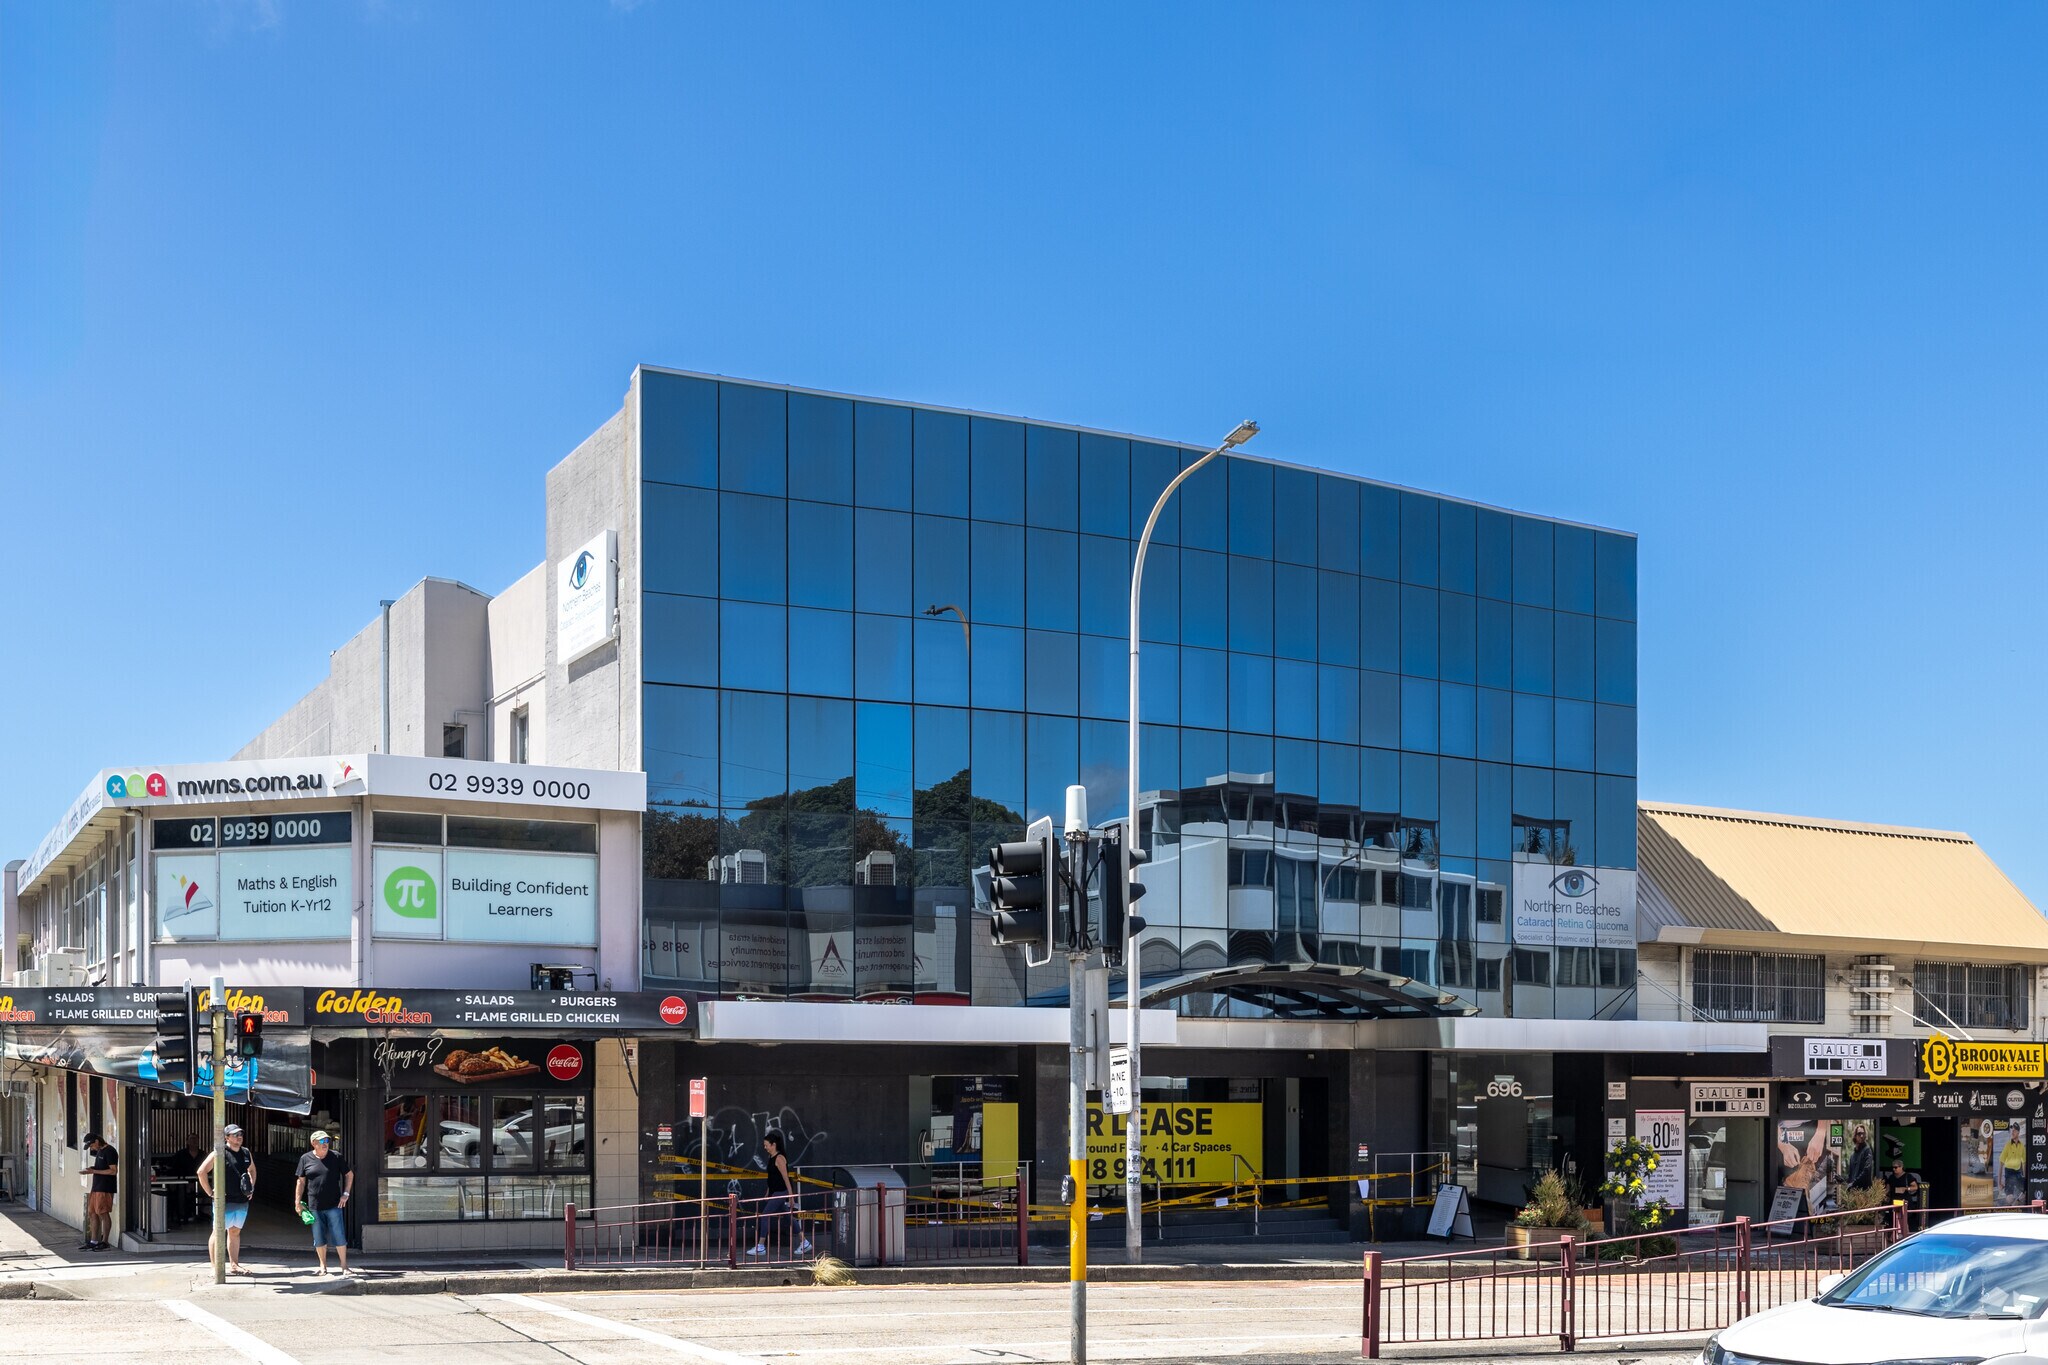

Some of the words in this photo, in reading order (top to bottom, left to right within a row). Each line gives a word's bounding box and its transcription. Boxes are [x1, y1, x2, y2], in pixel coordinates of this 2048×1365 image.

[178, 773, 322, 797] mwns.com.au
[429, 772, 457, 791] 02
[466, 775, 523, 796] 9939
[533, 780, 591, 800] 0000
[190, 824, 213, 842] 02
[223, 821, 269, 841] 9939
[274, 819, 321, 838] 0000
[237, 877, 276, 891] Maths
[279, 877, 288, 889] &
[292, 874, 337, 892] English
[452, 878, 512, 896] Building
[516, 881, 589, 896] Confident
[243, 900, 286, 913] Tuition
[291, 898, 331, 911] K-Yr12
[488, 903, 553, 917] Learners
[1524, 899, 1571, 914] Northern
[1576, 902, 1621, 916] Beaches
[1517, 917, 1553, 928] Cataract
[1558, 918, 1583, 929] Retina
[1586, 920, 1629, 931] Glaucoma
[1608, 938, 1633, 946] Surgeons
[55, 993, 95, 1003] SALADS
[198, 989, 264, 1013] Glden
[316, 989, 402, 1013] Golden
[465, 995, 515, 1005] SALADS
[559, 997, 617, 1007] BURGERS
[55, 1009, 89, 1019] FLAME
[91, 1009, 133, 1019] GRILLED
[364, 1008, 432, 1024] Chicken
[465, 1012, 507, 1022] FLAME
[510, 1012, 562, 1022] GRILLED
[566, 1013, 620, 1023] CHICKEN
[374, 1037, 443, 1069] Hungry?
[1813, 1045, 1858, 1055] SALE
[1960, 1048, 2041, 1063] BROOKVALE
[548, 1056, 581, 1068] Coca-Cola
[1846, 1060, 1879, 1069] LAB
[1962, 1063, 2005, 1071] WORKWEAR
[2013, 1064, 2040, 1072] SAFETY
[1111, 1071, 1126, 1081] ANE
[1487, 1081, 1523, 1097] 696
[1698, 1089, 1742, 1098] SALE
[1731, 1102, 1762, 1111] LAB
[1086, 1142, 1117, 1153] round
[1161, 1142, 1169, 1152] 4
[1172, 1142, 1191, 1153] Car
[1193, 1142, 1232, 1154] Spaces
[1162, 1157, 1196, 1178] 111
